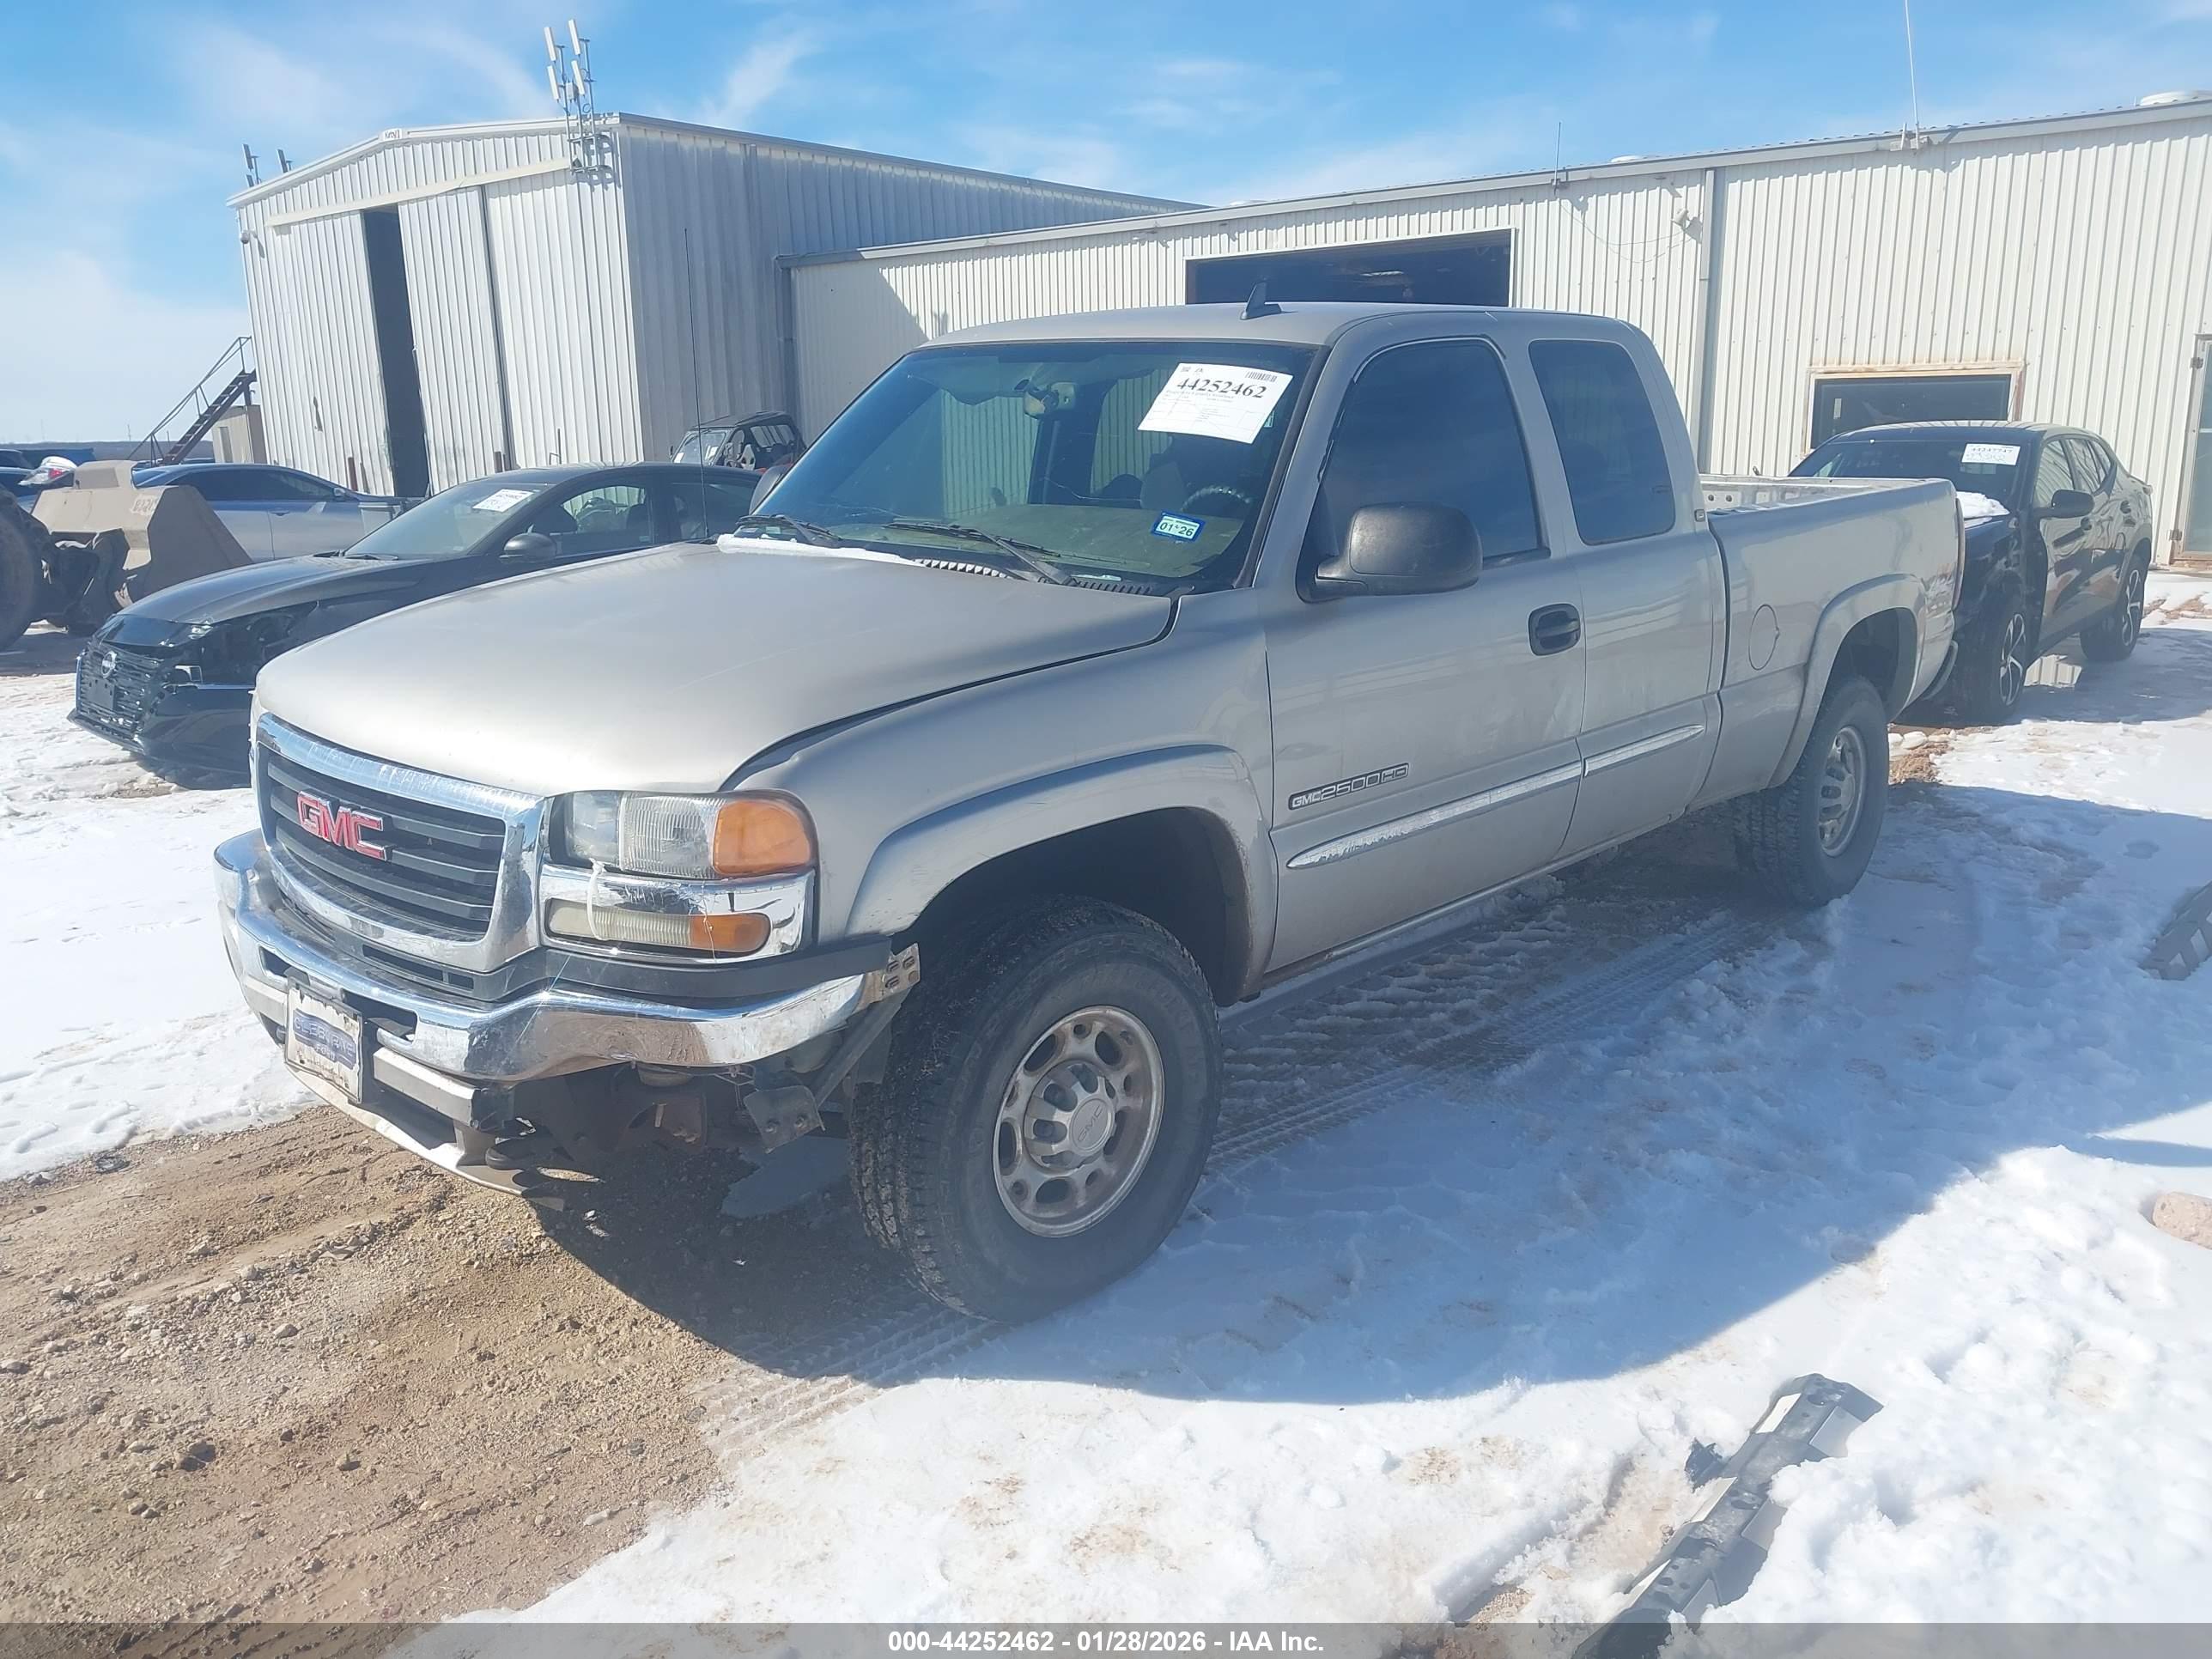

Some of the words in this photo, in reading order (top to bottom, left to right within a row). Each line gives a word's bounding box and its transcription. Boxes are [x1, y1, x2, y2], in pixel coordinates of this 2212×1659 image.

[1176, 377, 1267, 399] 44252462
[1159, 522, 1174, 532] 01
[1178, 526, 1194, 537] 26
[297, 790, 387, 862] GMC
[1078, 1104, 1103, 1142] GMC
